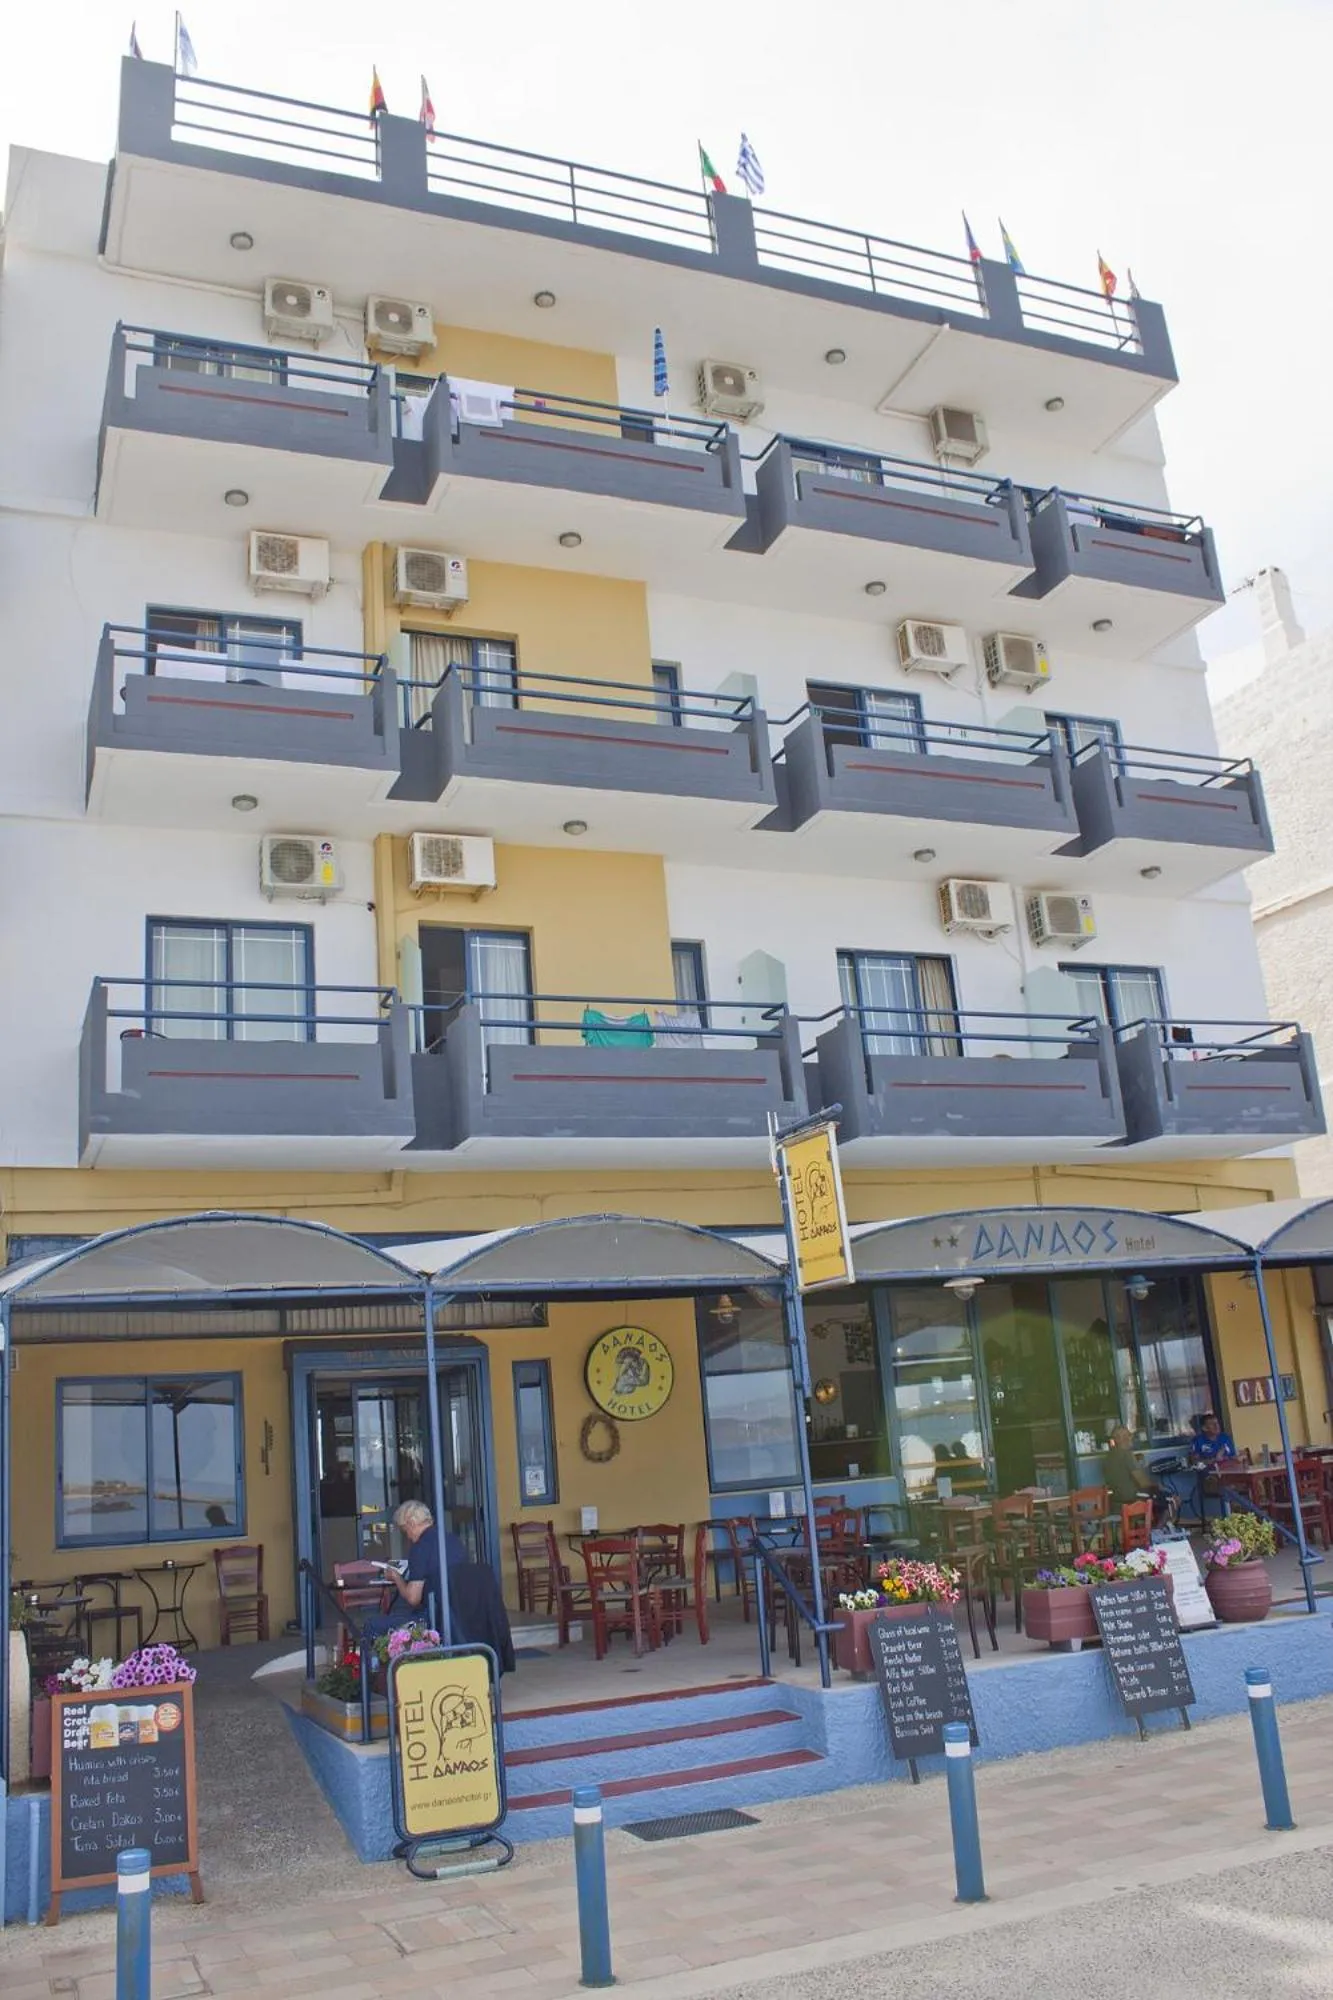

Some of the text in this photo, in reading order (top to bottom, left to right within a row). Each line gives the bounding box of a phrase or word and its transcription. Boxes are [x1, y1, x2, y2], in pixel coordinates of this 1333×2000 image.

[792, 1168, 808, 1241] HOTEL
[1124, 1236, 1155, 1252] Hotel
[607, 1398, 653, 1415] HOTEL
[905, 1695, 927, 1707] Coffee
[63, 1704, 87, 1716] Real
[63, 1726, 91, 1738] Draft
[404, 1690, 429, 1781] HOTEL
[63, 1738, 88, 1749] Beer
[107, 1756, 126, 1767] with
[102, 1772, 129, 1784] bread
[70, 1793, 101, 1809] Baked
[106, 1791, 126, 1804] Feta
[70, 1816, 105, 1831] Cretan
[112, 1811, 143, 1828] Dakos
[105, 1833, 136, 1849] Salad
